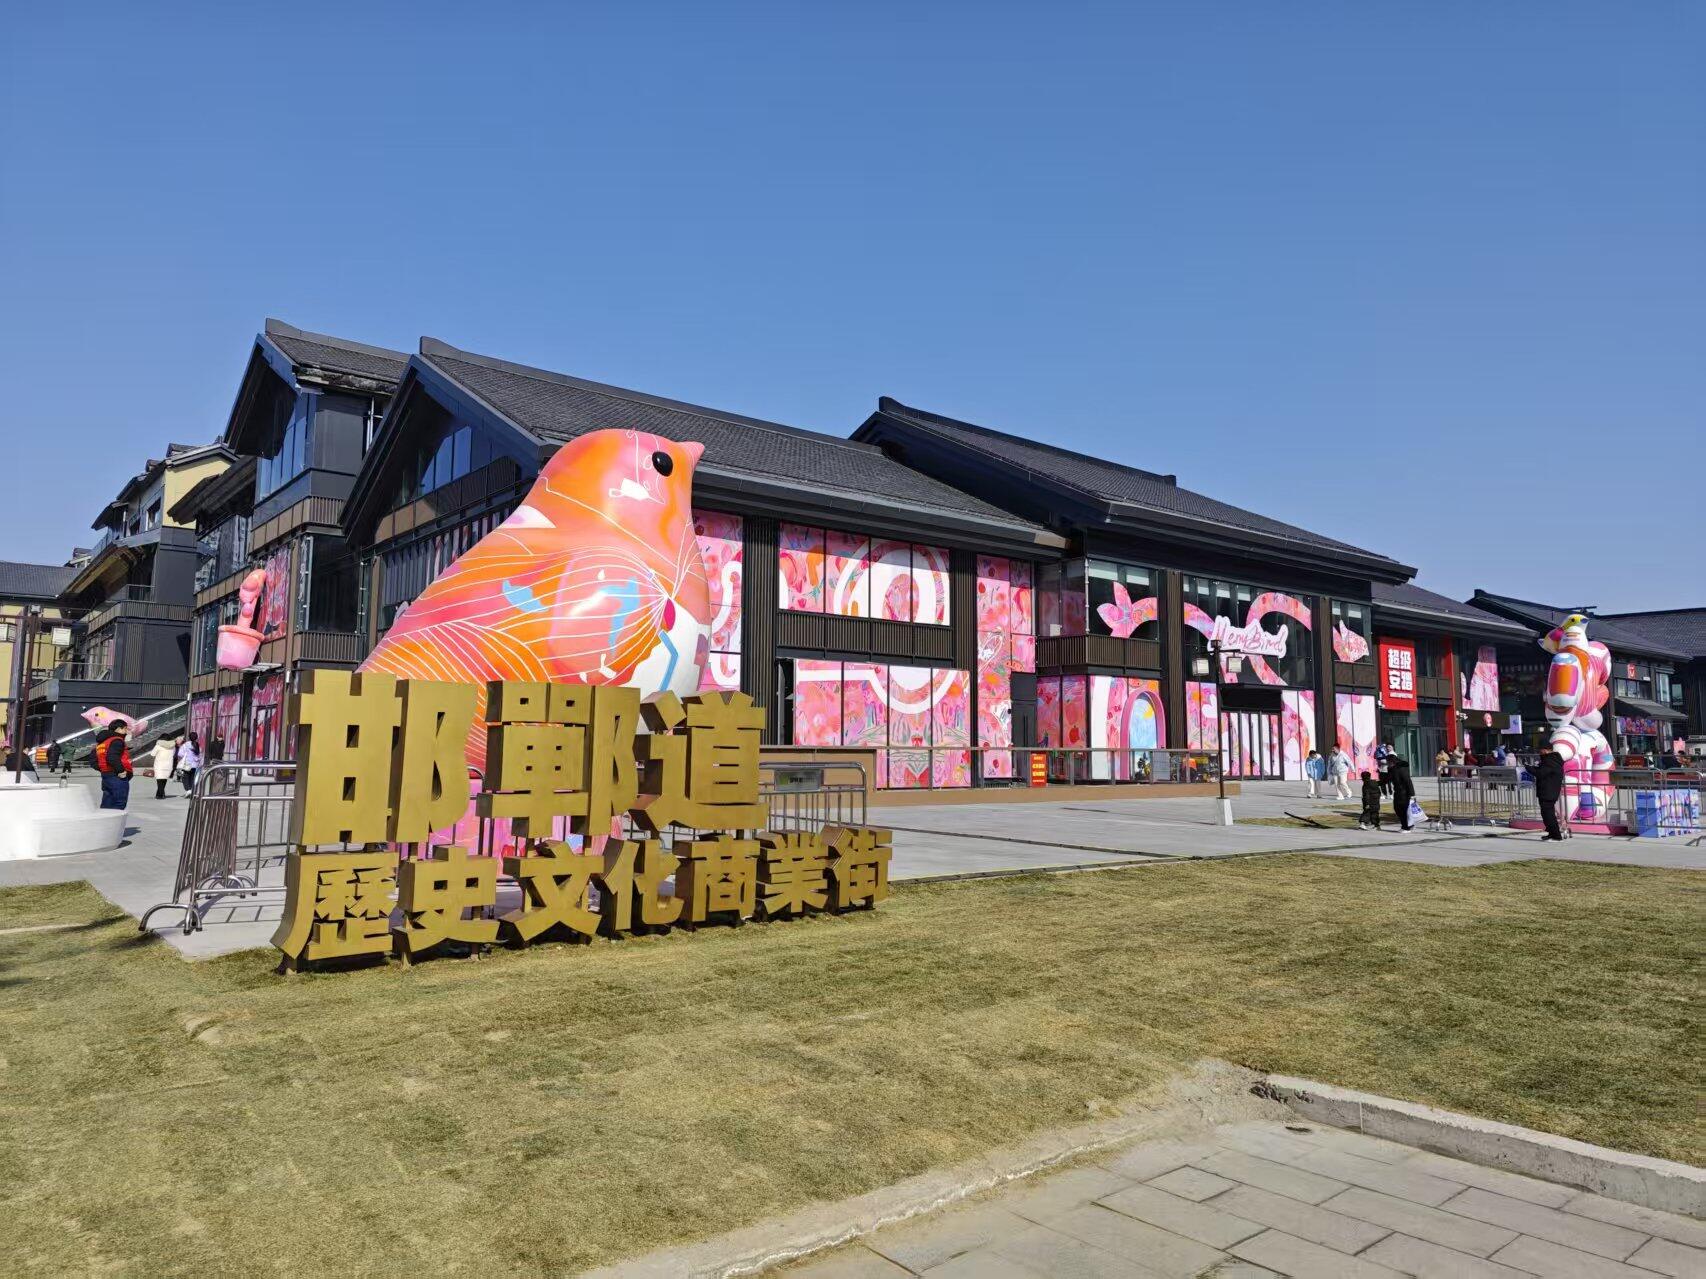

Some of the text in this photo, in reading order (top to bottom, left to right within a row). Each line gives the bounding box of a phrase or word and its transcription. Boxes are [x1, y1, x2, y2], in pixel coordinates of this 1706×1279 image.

[1387, 648, 1411, 671] 超级
[288, 669, 770, 845] 邯鄲道
